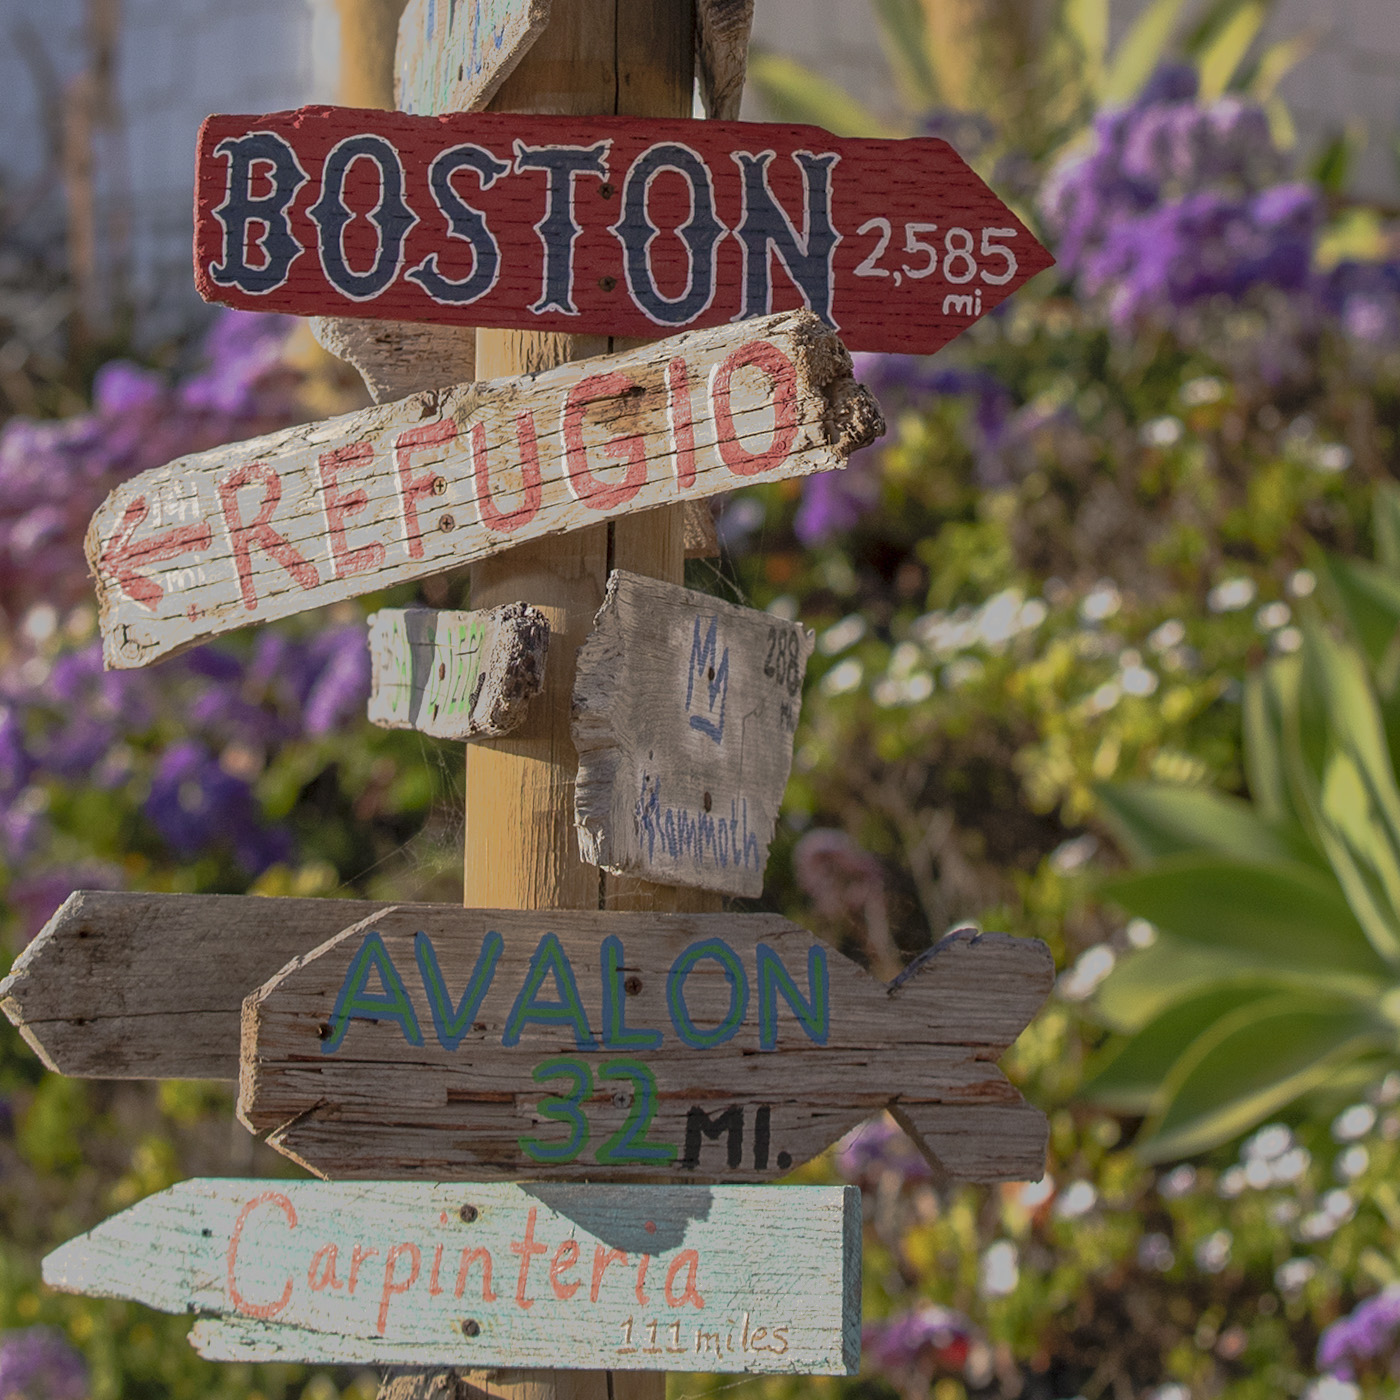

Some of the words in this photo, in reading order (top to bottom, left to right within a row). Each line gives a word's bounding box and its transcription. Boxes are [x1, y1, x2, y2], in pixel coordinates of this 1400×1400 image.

[209, 130, 844, 333] BOSTON
[853, 217, 1019, 287] 2,585
[942, 288, 982, 316] mi
[217, 340, 800, 612] REFUGIO
[319, 929, 831, 1053] AVALON
[517, 1056, 679, 1166] 32
[681, 1103, 792, 1171] MI.
[226, 1190, 706, 1335] Carpinteria
